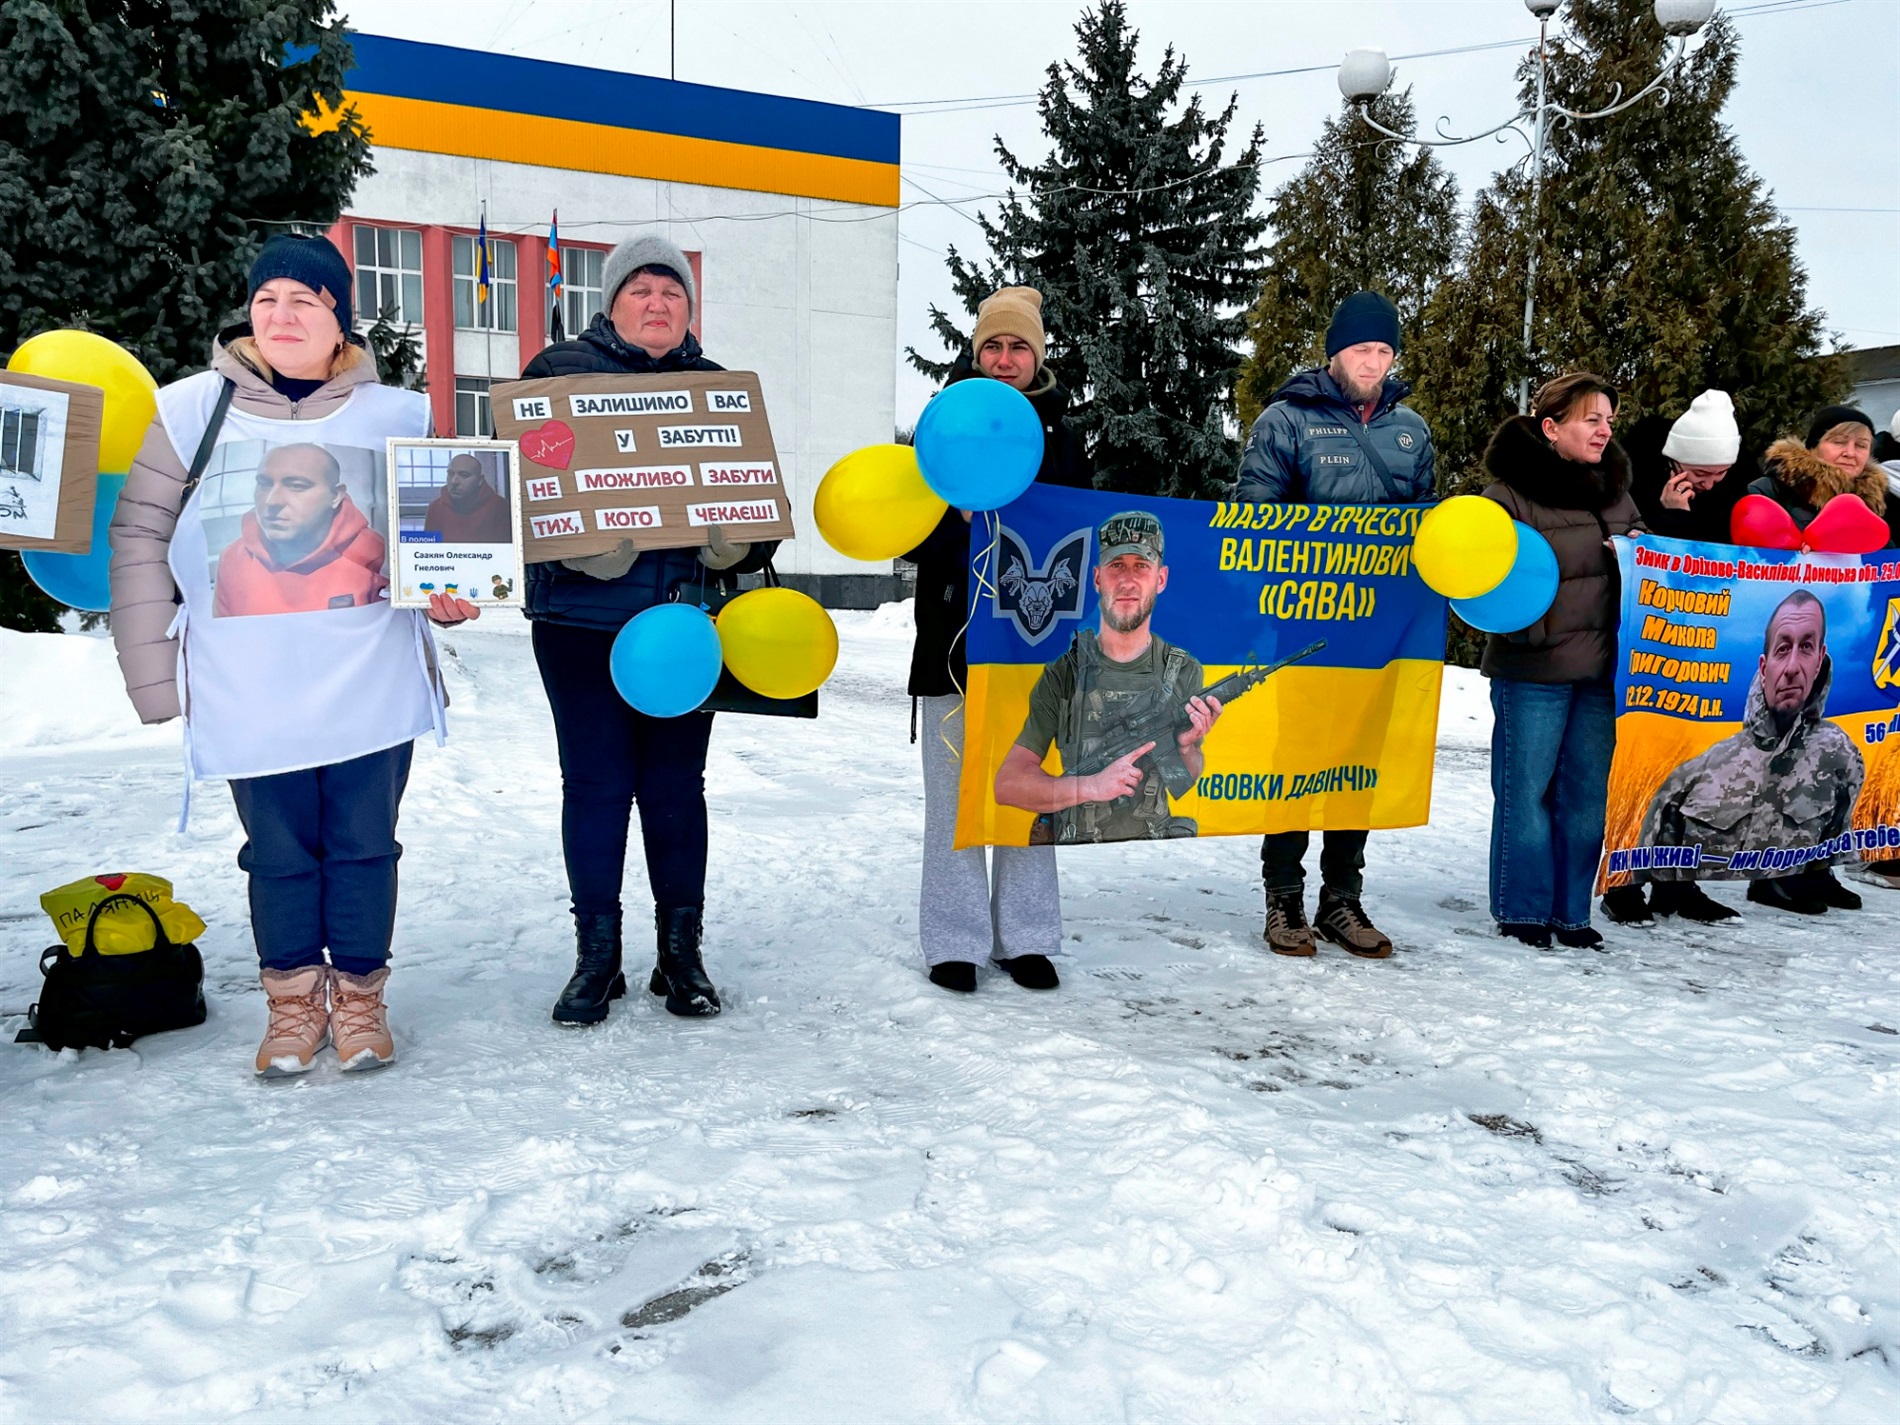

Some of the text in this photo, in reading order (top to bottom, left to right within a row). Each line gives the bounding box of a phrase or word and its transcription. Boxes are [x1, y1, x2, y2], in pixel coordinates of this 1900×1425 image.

[520, 394, 748, 418] НЕ ЗАЛИШИМО ВАС
[617, 427, 736, 448] У ЗАБУТТІ!
[1308, 427, 1348, 436] PHILIPP
[1320, 456, 1350, 464] PLEIN
[532, 469, 774, 498] НЕ МОЖЛИВО ЗАБУТИ
[534, 505, 774, 536] ТИХ, КОГО ЧЕКАЄШ!
[1209, 502, 1434, 537] МАЗУР В'ЯЧЕСЛ
[446, 552, 492, 560] Олександр
[1671, 556, 1681, 572] в
[1803, 563, 1857, 584] Донецька
[1858, 565, 1879, 582] обл.
[1259, 580, 1376, 621] «СЯВА»
[1638, 579, 1731, 616] Корчовий
[1641, 614, 1716, 648] Микола
[1629, 648, 1731, 683] ригорович
[1700, 698, 1723, 718] р.н.
[1866, 722, 1886, 744] 56
[1197, 765, 1378, 802] «ВОВКИ ДАВІНЧІ»
[1653, 844, 1702, 869] живі
[1728, 850, 1760, 870] ми
[1854, 824, 1900, 850] тебе
